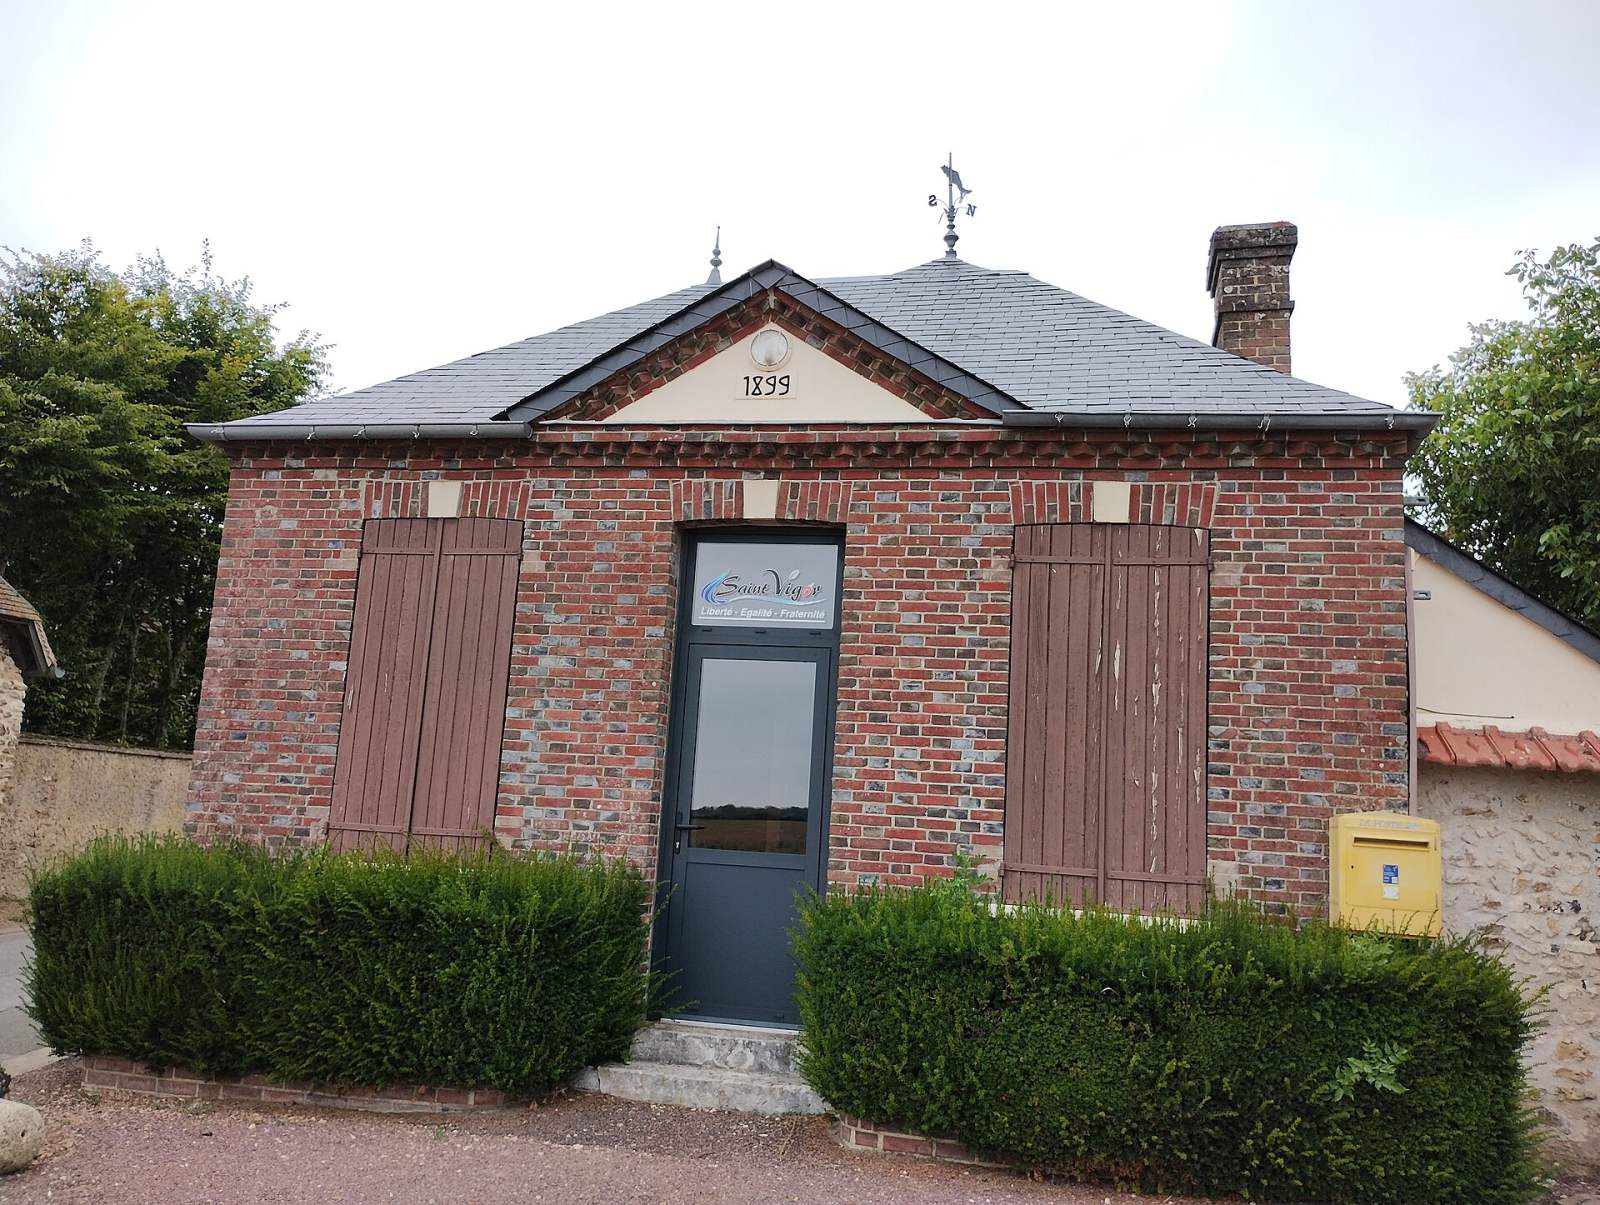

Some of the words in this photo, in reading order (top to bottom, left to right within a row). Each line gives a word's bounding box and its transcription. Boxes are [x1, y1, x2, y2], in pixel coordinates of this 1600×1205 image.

[715, 575, 768, 597] Saint
[761, 569, 821, 601] Vigor
[780, 609, 825, 619] Fraternité
